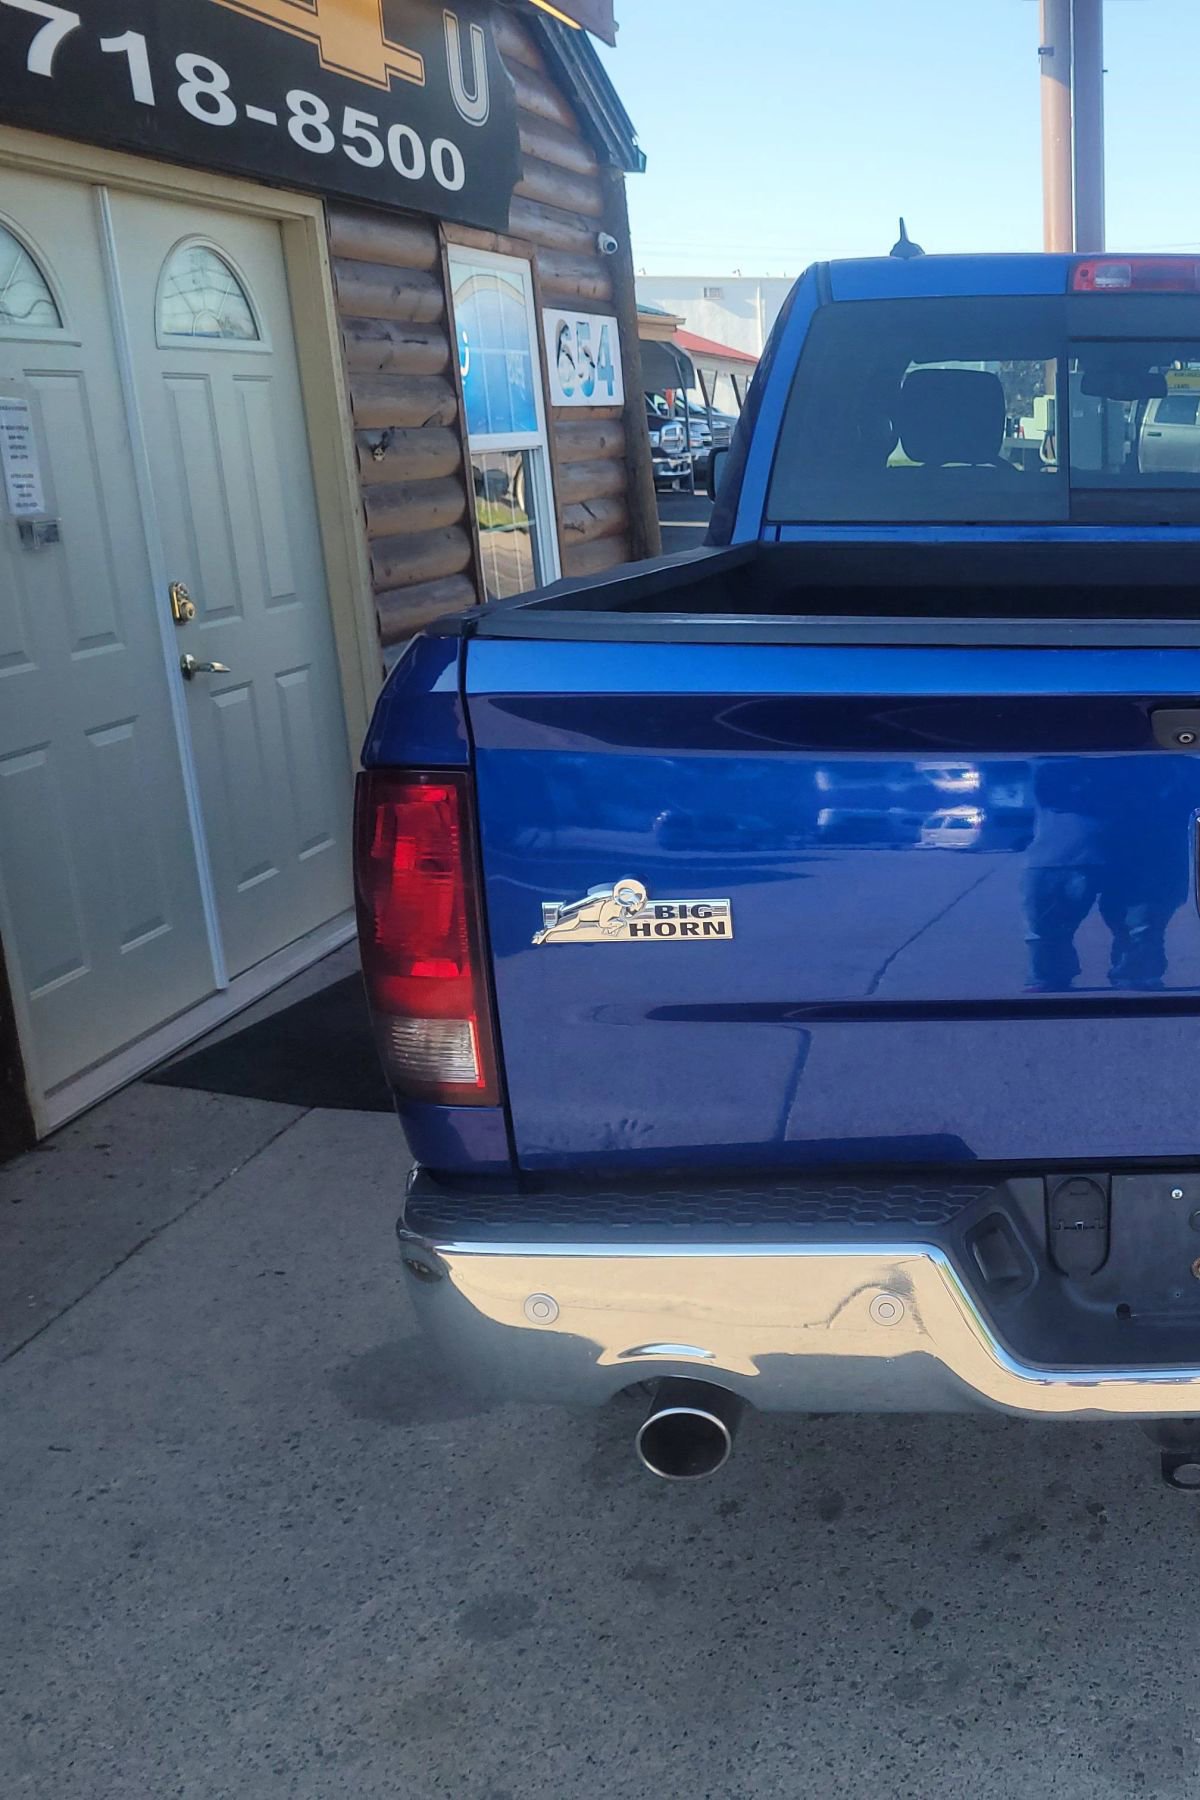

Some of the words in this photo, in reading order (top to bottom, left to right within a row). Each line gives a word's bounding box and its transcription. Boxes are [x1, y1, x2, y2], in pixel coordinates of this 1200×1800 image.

[0, 0, 466, 191] 718-8500
[443, 8, 490, 127] U
[629, 921, 726, 937] HORN
[655, 904, 713, 919] BIG
